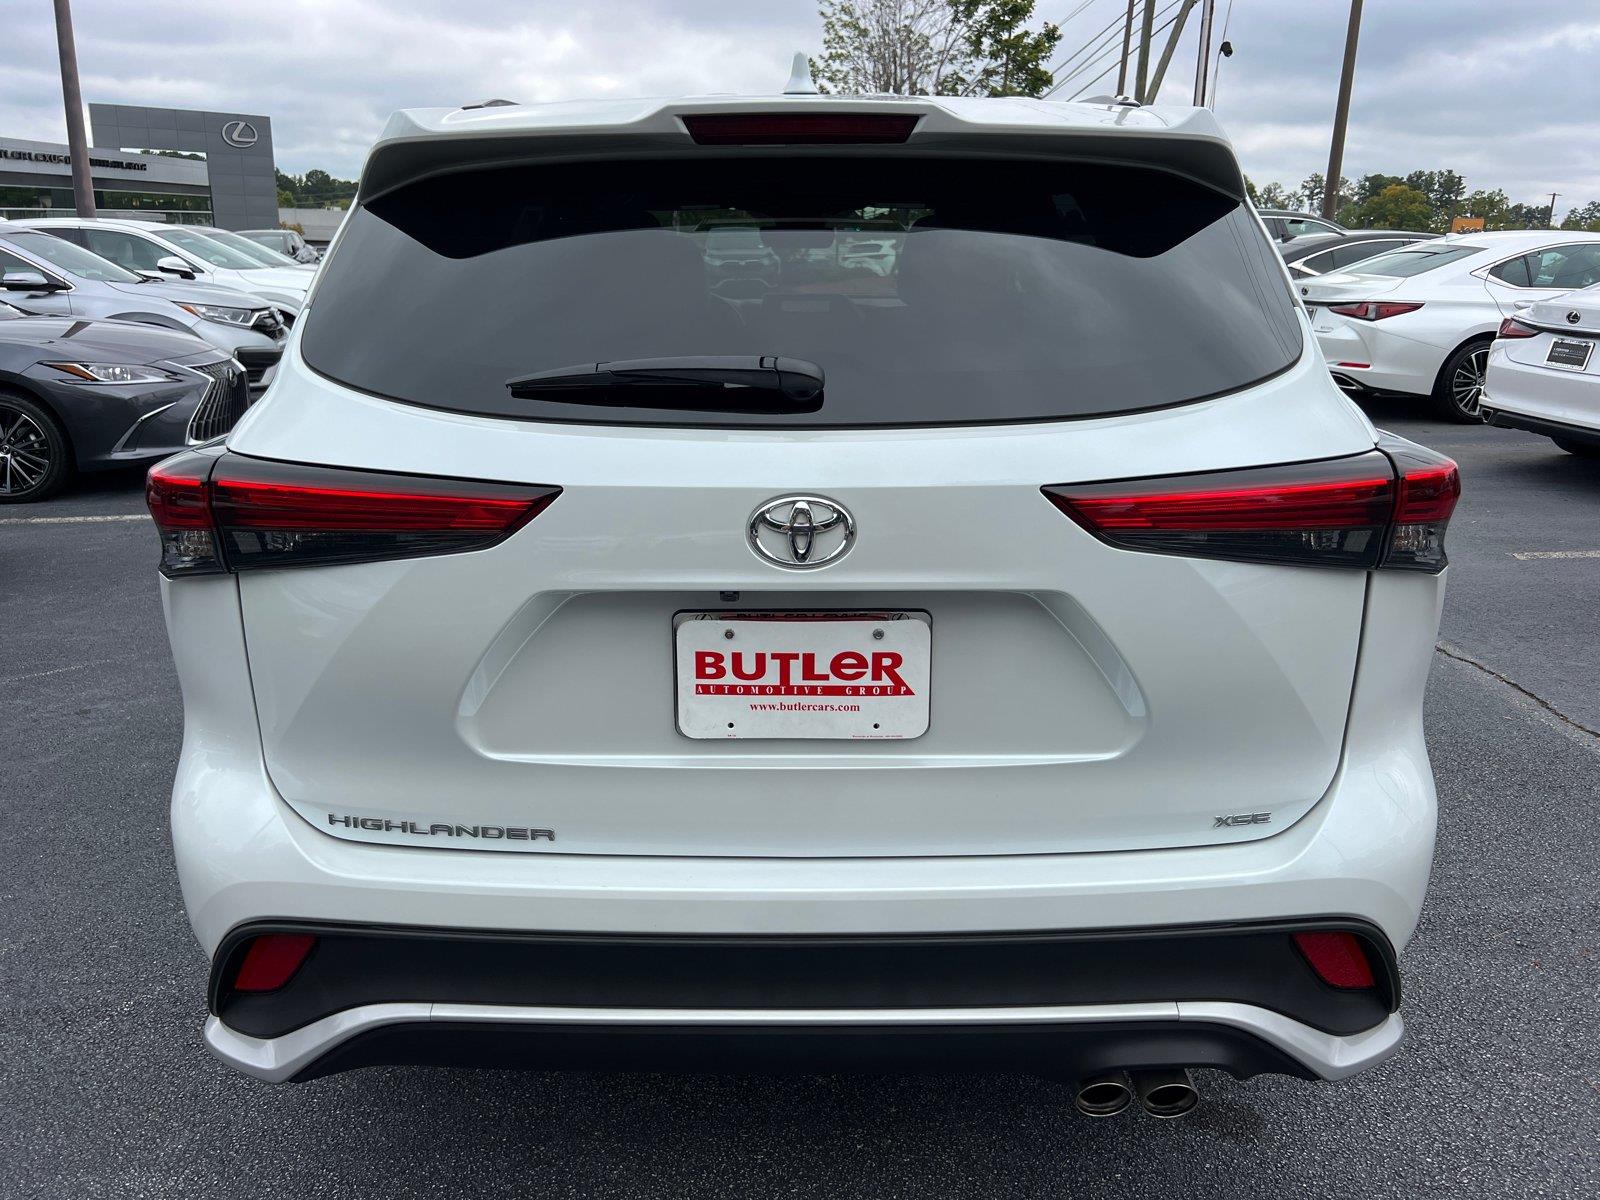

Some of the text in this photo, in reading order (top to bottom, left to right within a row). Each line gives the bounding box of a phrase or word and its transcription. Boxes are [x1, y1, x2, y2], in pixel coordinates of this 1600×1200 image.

[696, 685, 908, 696] AUTOMOTIVE GROUP
[750, 702, 860, 713] www.butlercars.com
[1213, 811, 1272, 828] XSE
[327, 812, 556, 842] HIGHLANDER
